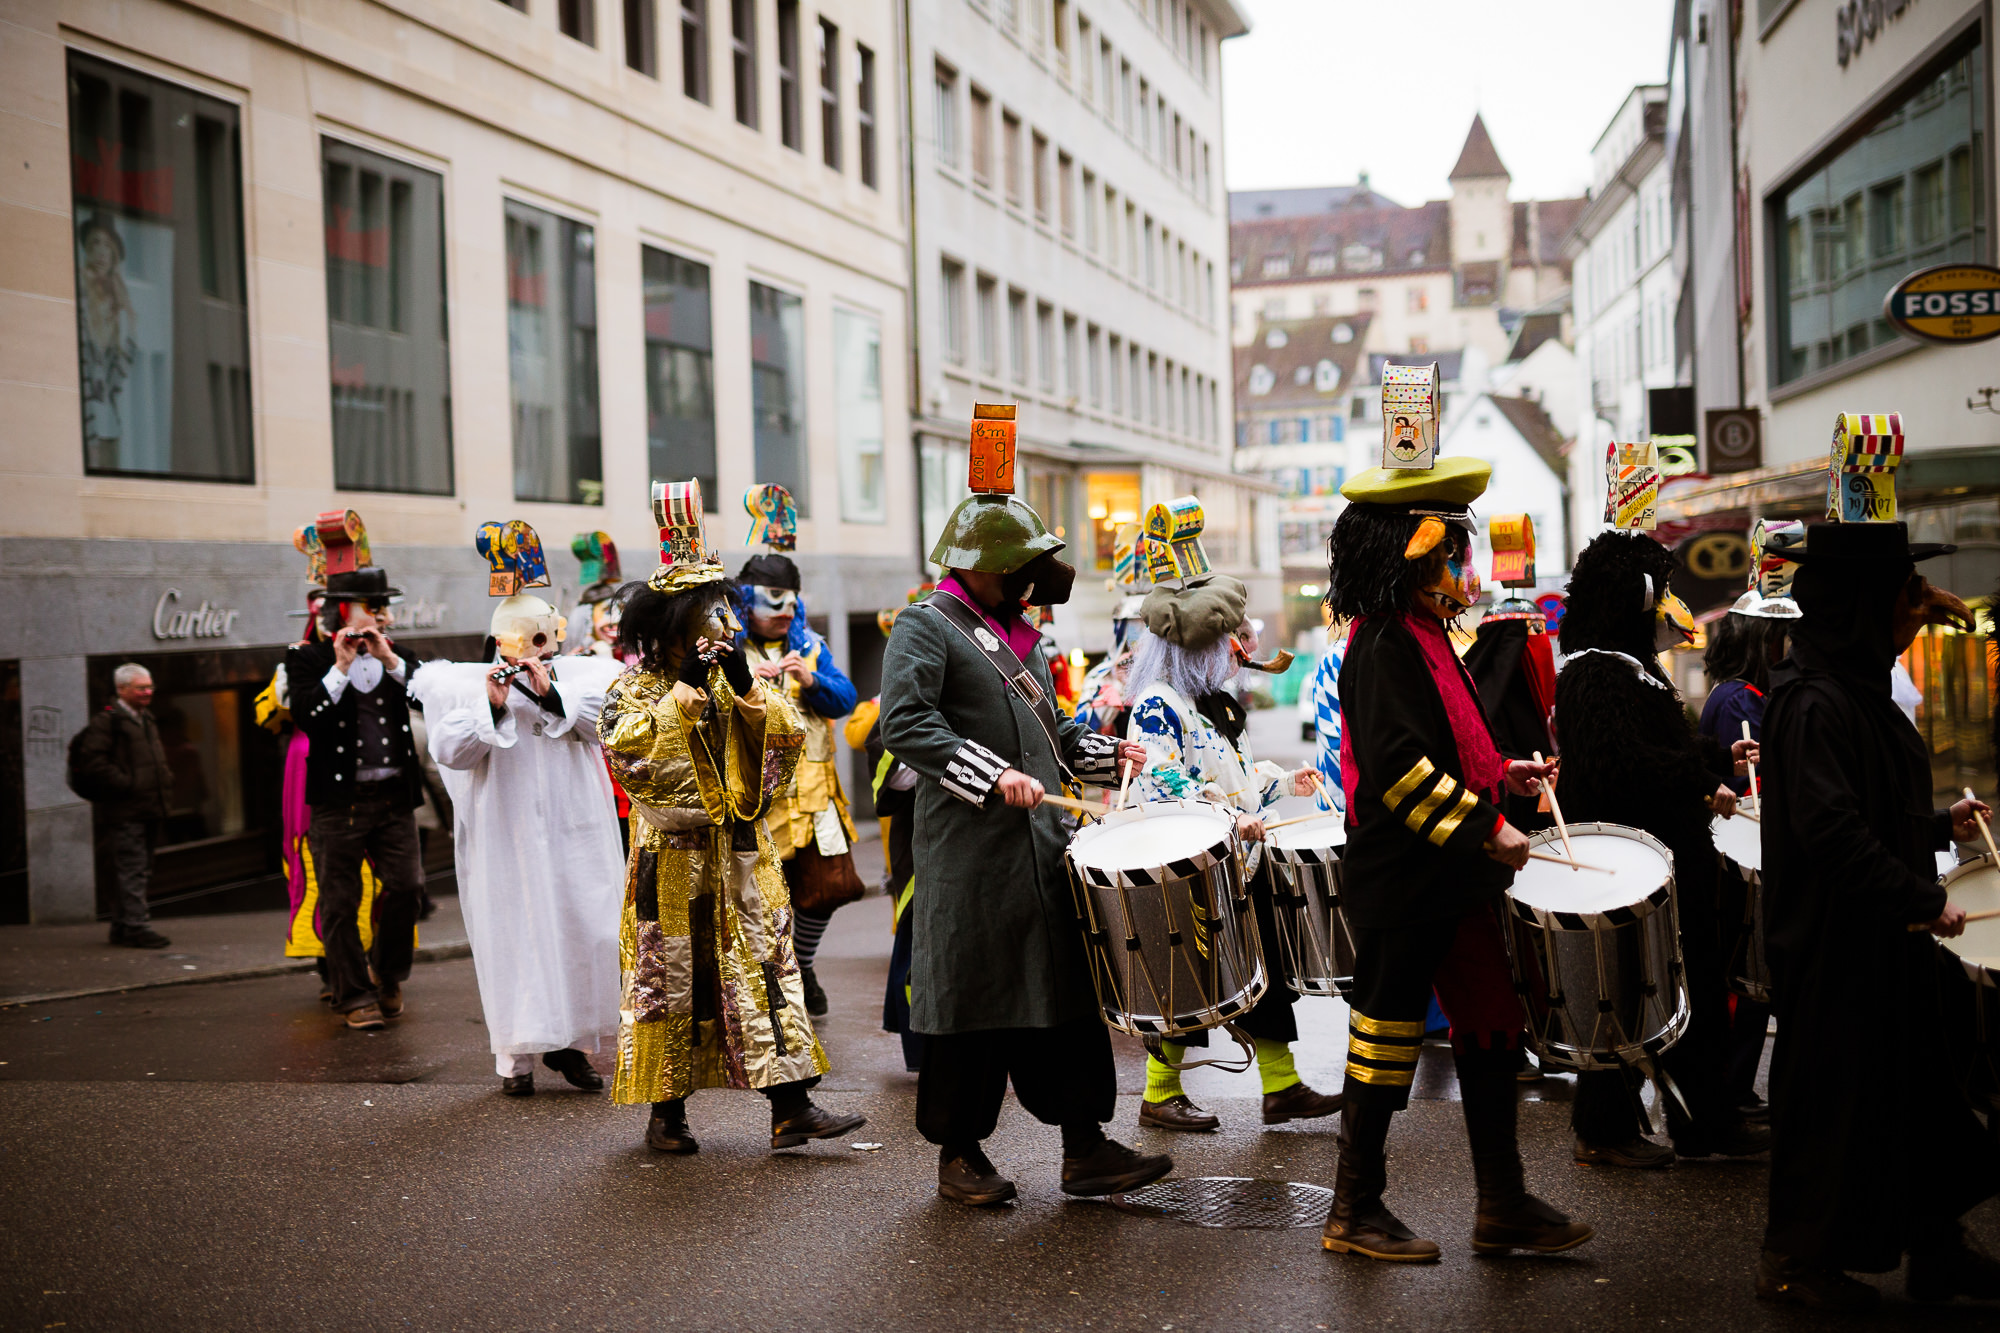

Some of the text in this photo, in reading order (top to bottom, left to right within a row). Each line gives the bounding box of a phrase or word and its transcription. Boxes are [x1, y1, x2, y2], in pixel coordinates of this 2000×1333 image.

[973, 454, 985, 482] 1907
[154, 588, 239, 640] Cartier
[386, 594, 448, 630] artier
